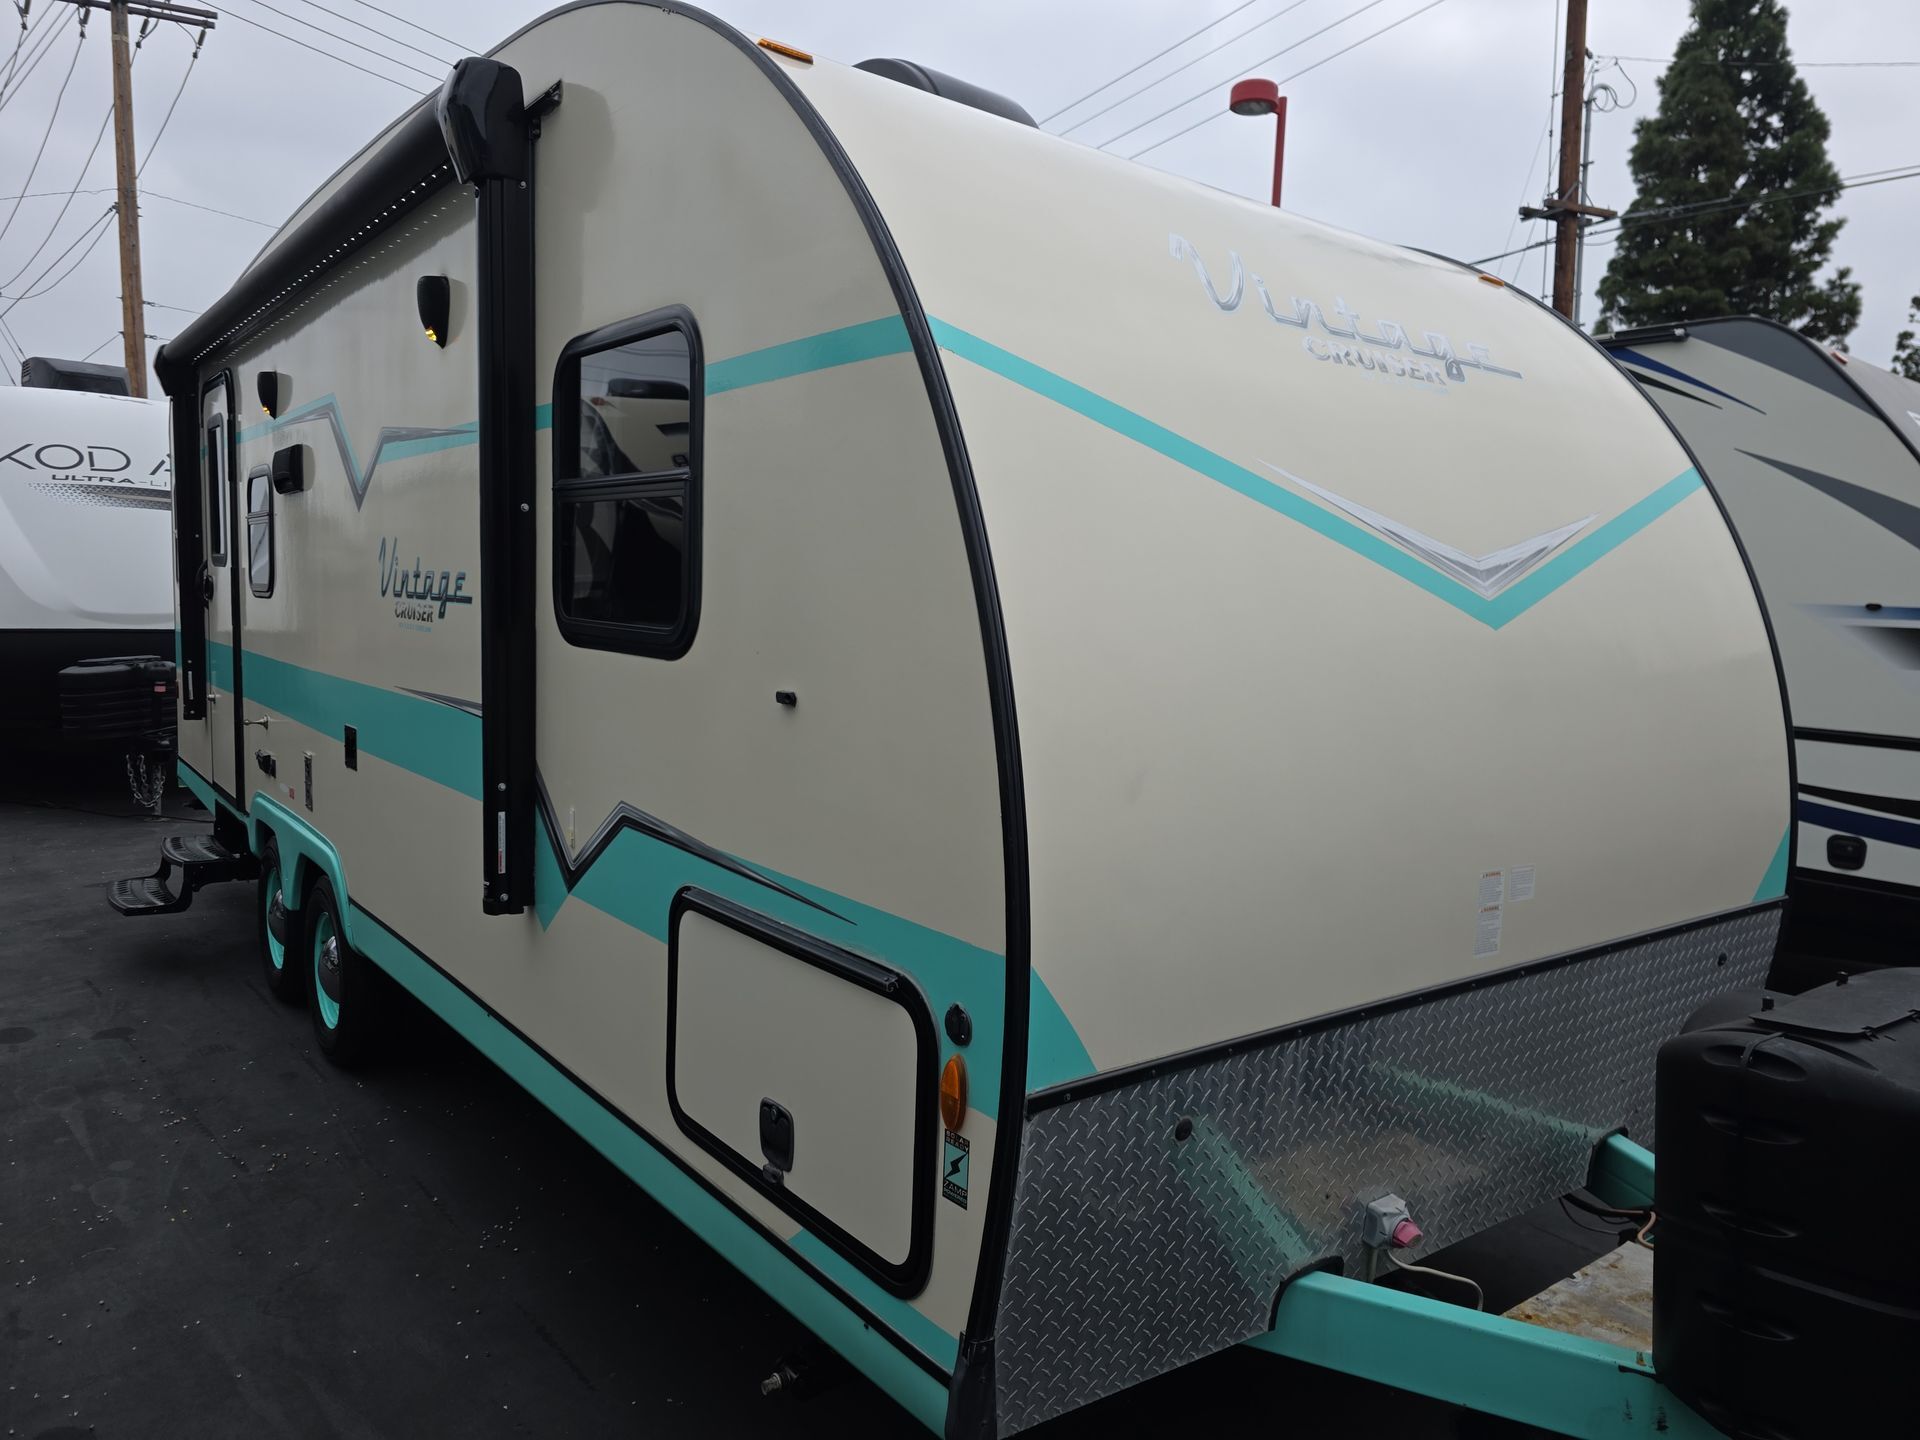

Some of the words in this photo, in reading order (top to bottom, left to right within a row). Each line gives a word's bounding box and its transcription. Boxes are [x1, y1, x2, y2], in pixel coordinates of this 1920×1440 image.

[1168, 232, 1522, 382] Vintage
[1303, 335, 1448, 386] CRUISER
[51, 474, 168, 488] ULTRA-LI
[378, 537, 473, 619] Vintage
[395, 601, 434, 623] CRUISER
